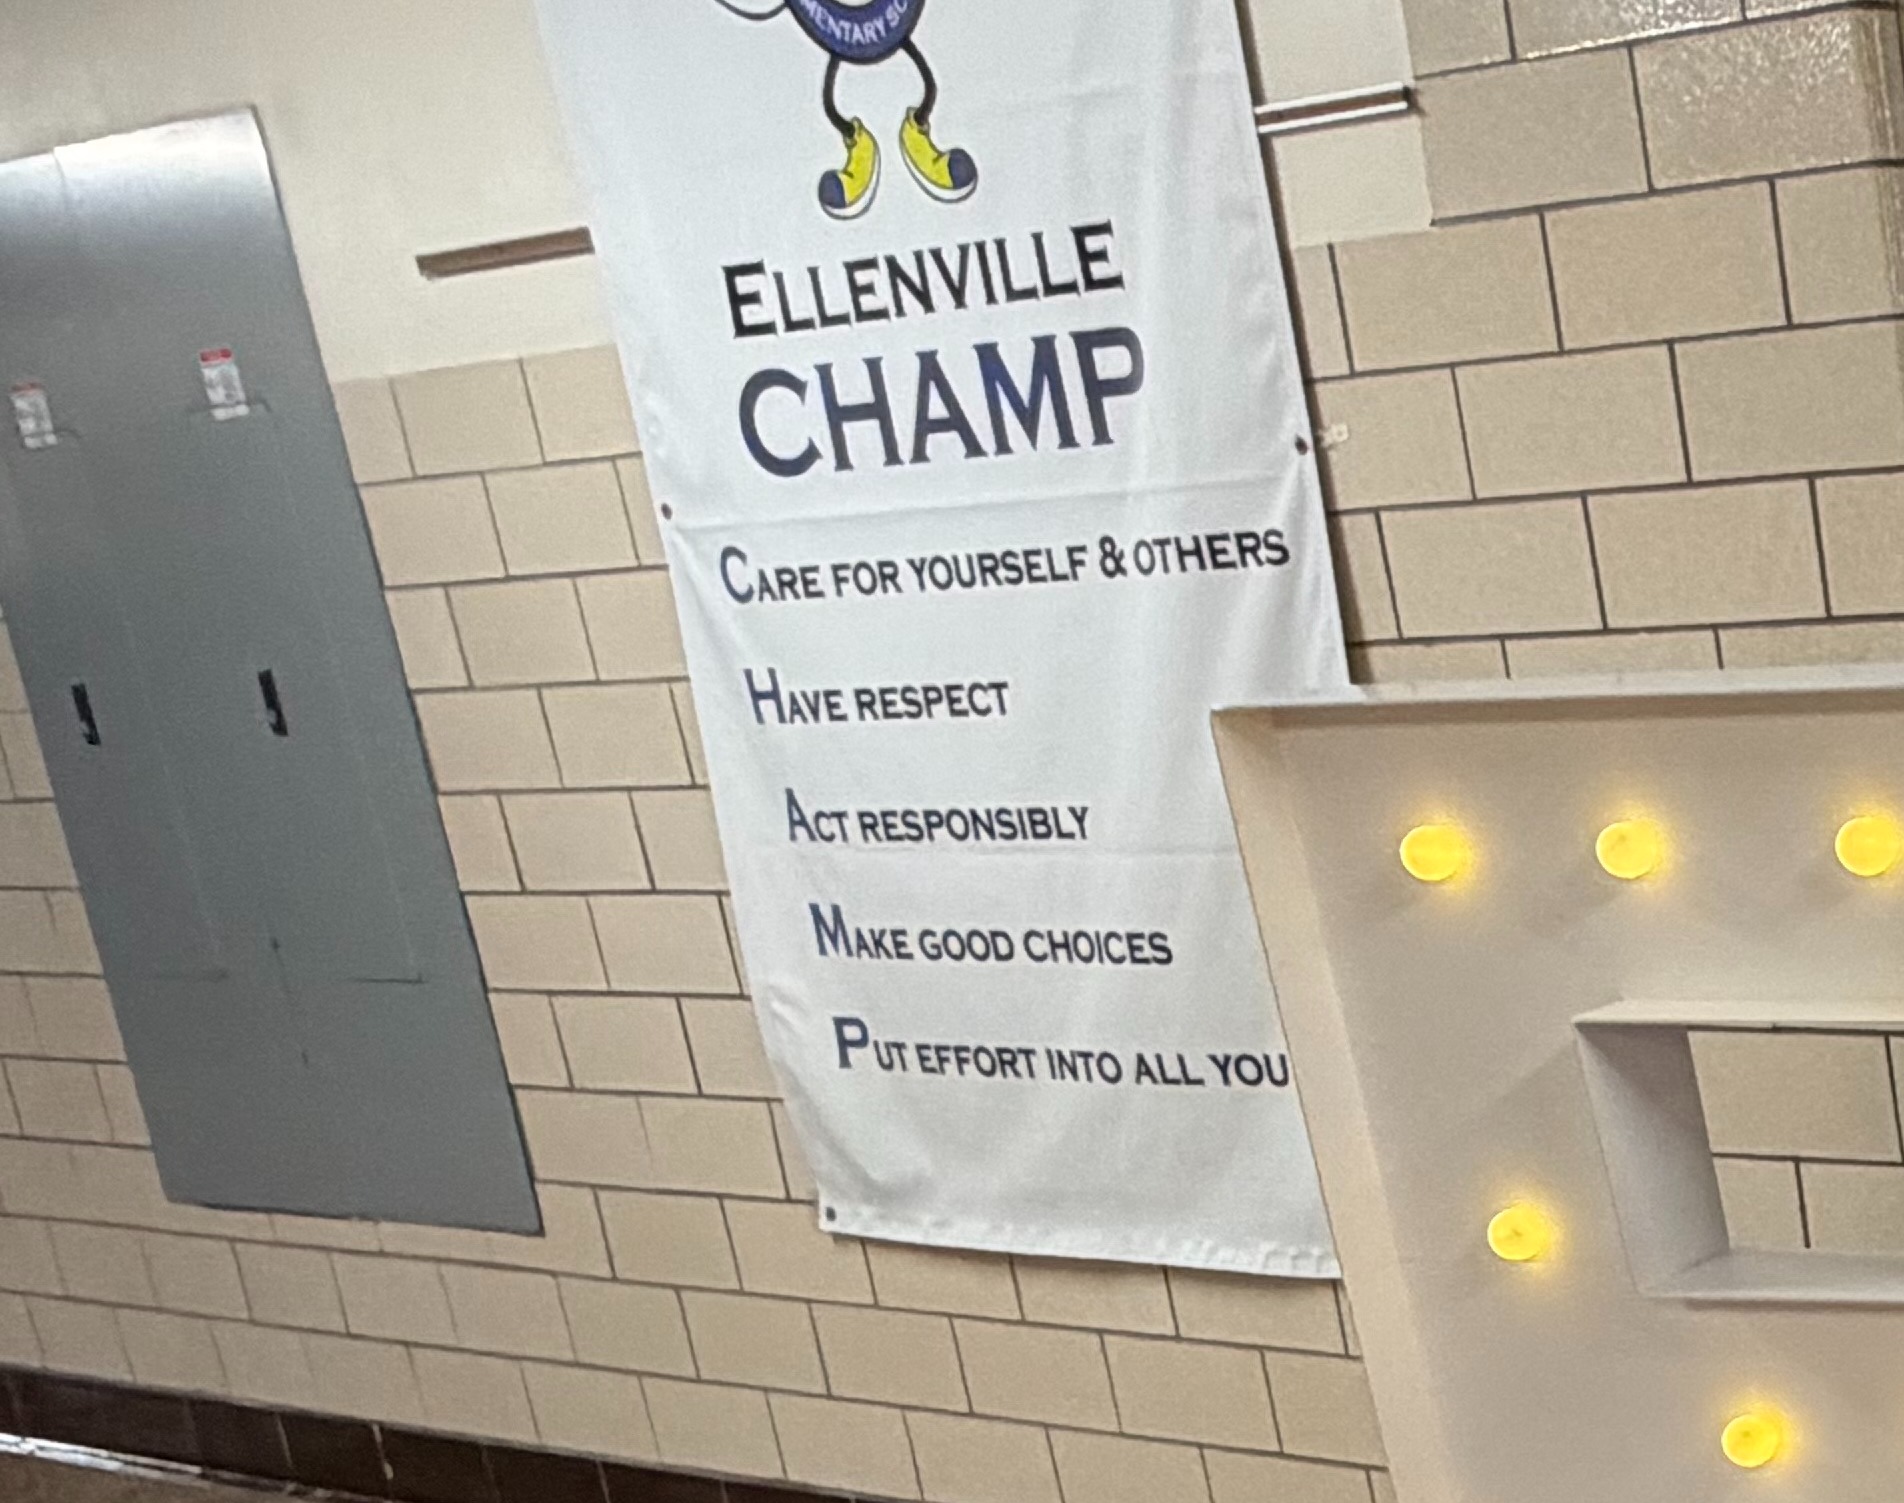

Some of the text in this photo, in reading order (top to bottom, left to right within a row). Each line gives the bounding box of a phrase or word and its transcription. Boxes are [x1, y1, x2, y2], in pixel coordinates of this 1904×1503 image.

[799, 0, 886, 45] MENTARY
[721, 219, 1126, 338] ELLENVILLE
[737, 326, 1145, 477] CHAMP
[720, 529, 1292, 604] CARE FOR YOURSELF & OTHERS
[744, 667, 1009, 725] HAVE RESPECT
[784, 787, 1089, 844] ACT RESPONSIBLY
[808, 902, 1174, 966] MAKE GOOD CHOICES
[832, 1015, 1290, 1088] PUT EFFORT INTO ALL YOU
